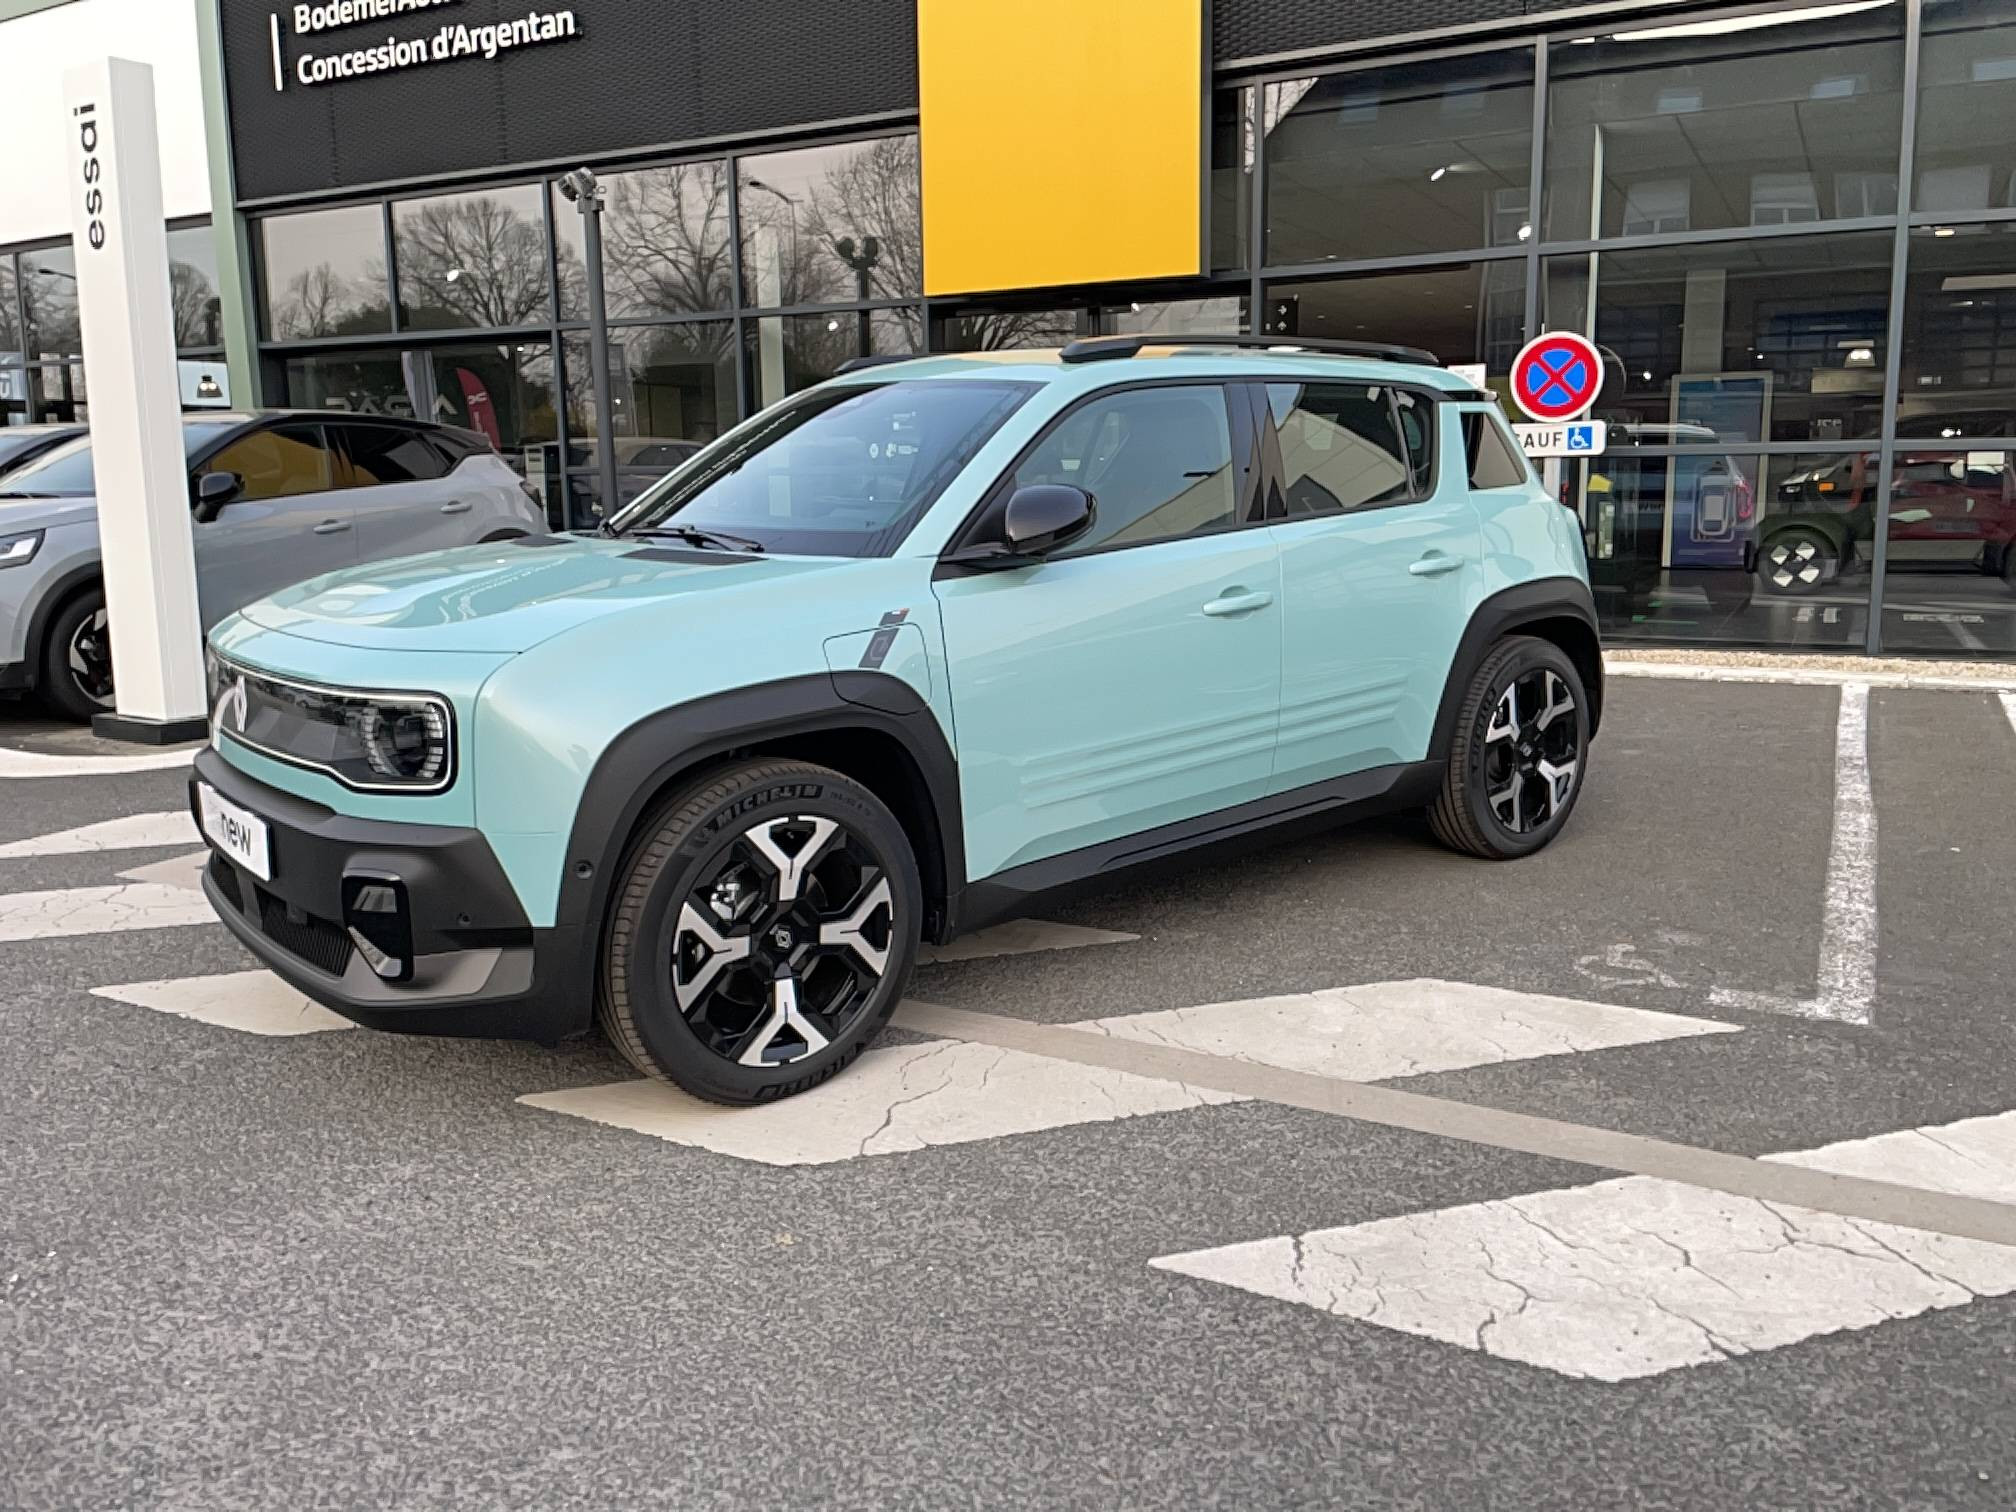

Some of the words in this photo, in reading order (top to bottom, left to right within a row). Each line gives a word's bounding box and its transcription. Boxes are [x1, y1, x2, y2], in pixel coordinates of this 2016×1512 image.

[298, 37, 428, 84] Concession
[432, 10, 576, 58] d'Argentan
[73, 103, 105, 250] essai
[1515, 432, 1563, 448] AUF
[717, 785, 821, 829] MICHELIN
[221, 811, 251, 856] new
